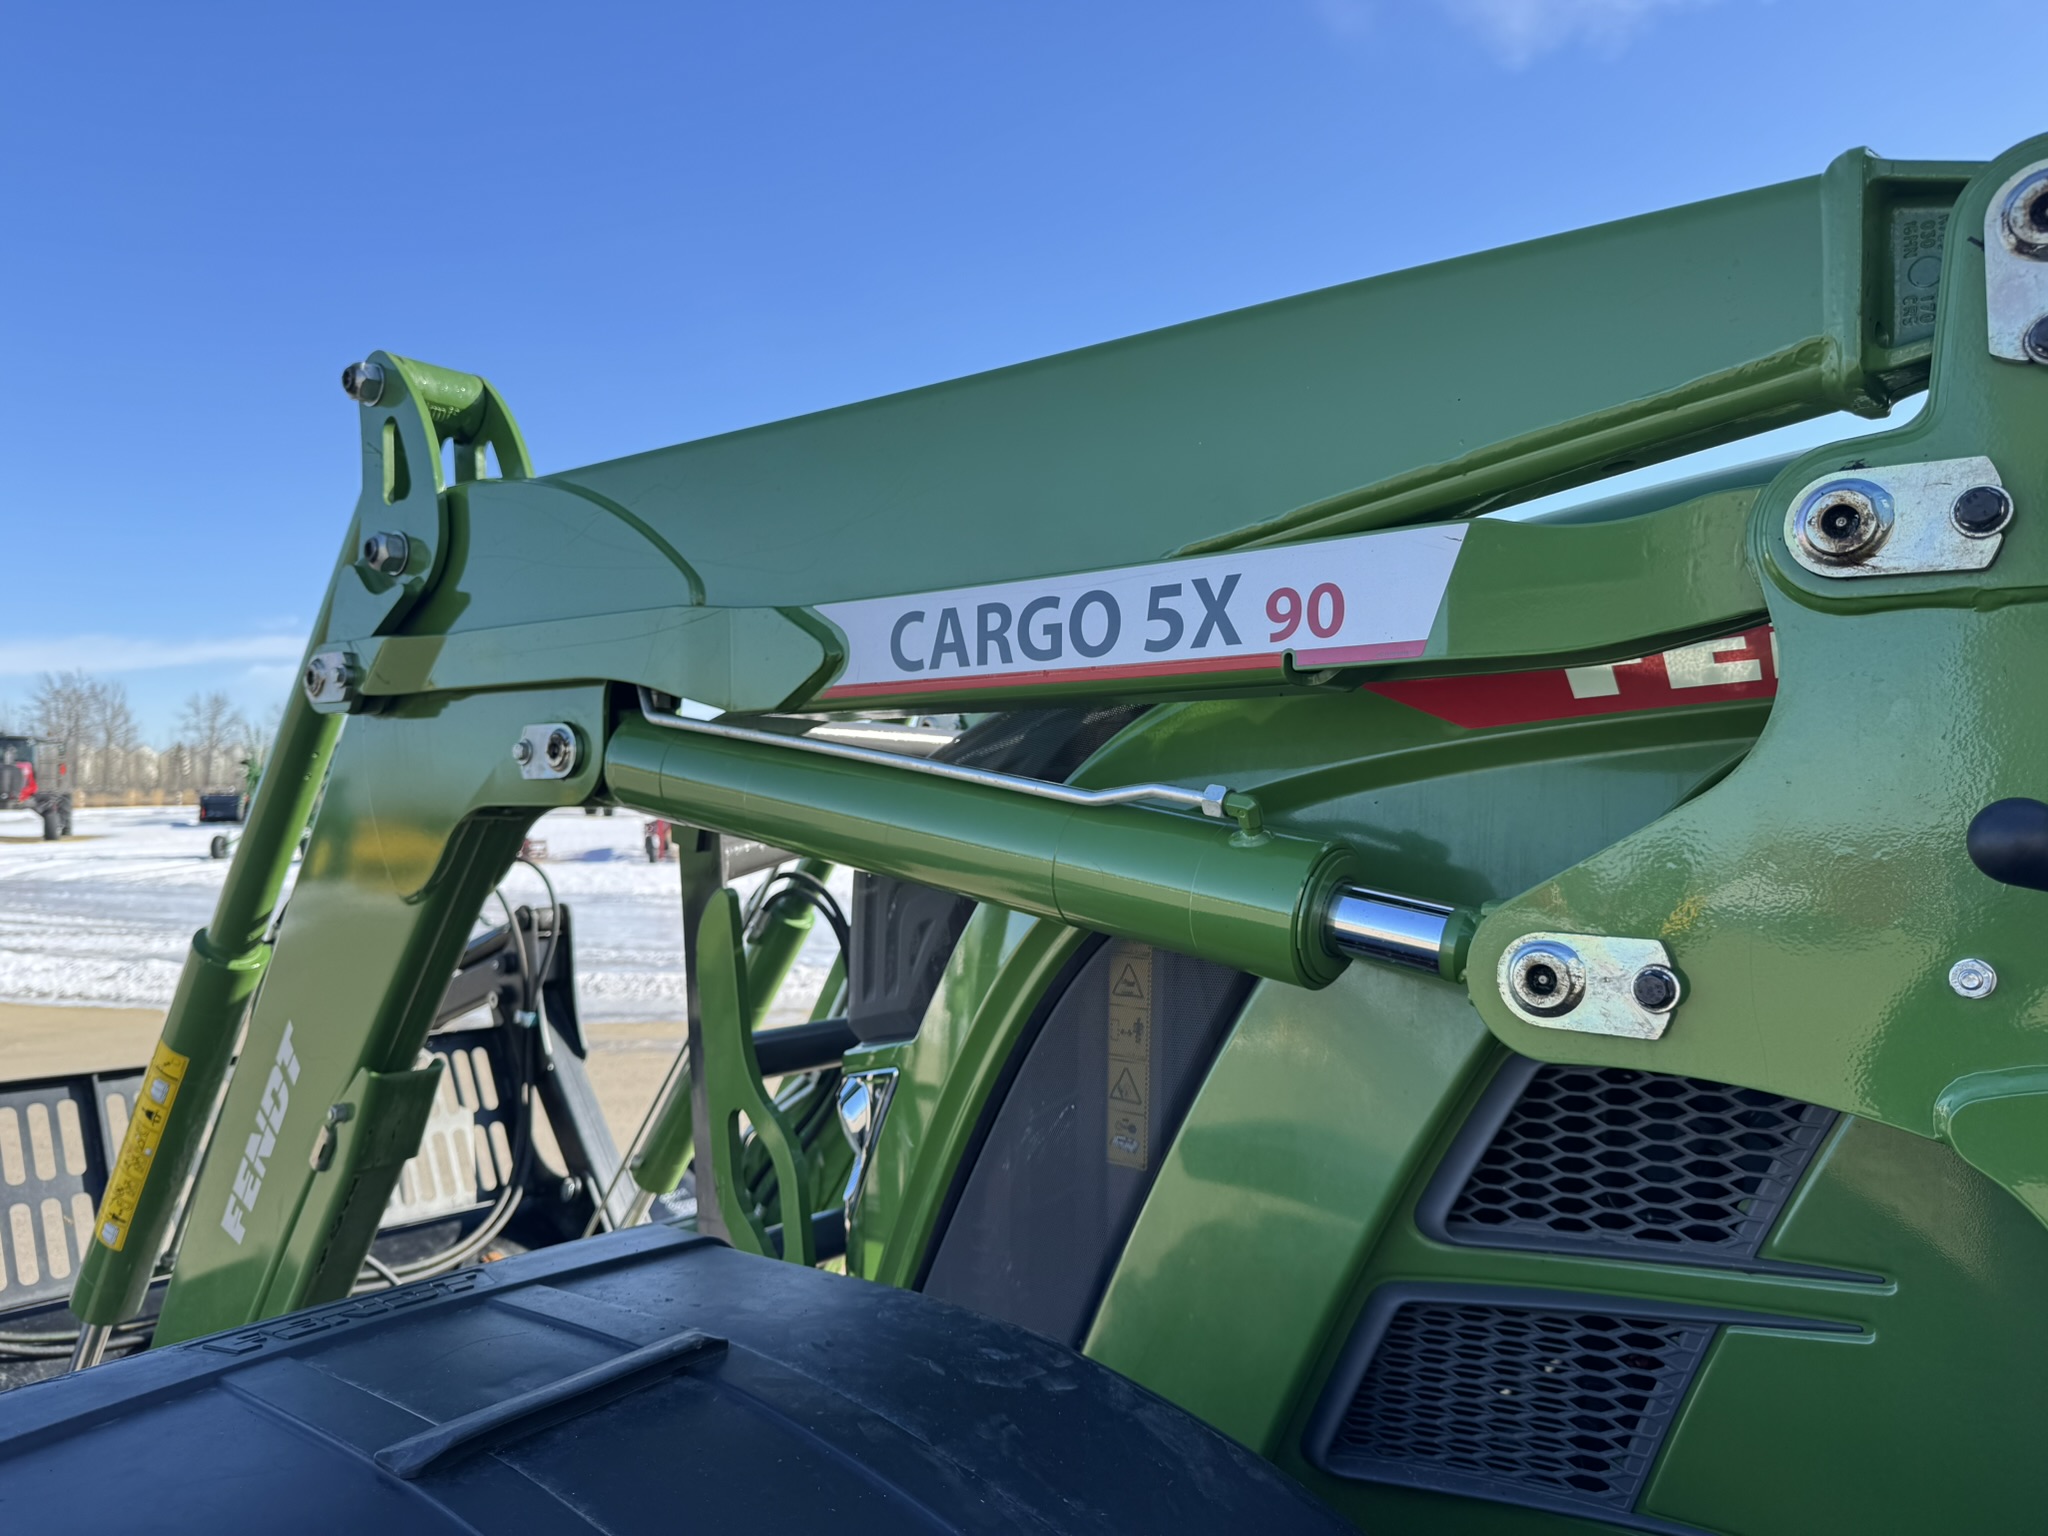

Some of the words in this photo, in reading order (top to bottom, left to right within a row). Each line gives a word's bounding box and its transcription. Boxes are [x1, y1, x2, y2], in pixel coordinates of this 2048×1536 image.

[890, 589, 1121, 673] CARGO
[1144, 573, 1243, 653] 5X
[1265, 582, 1346, 643] 90
[220, 1019, 301, 1246] FENDT
[202, 1272, 478, 1355] FENDT
